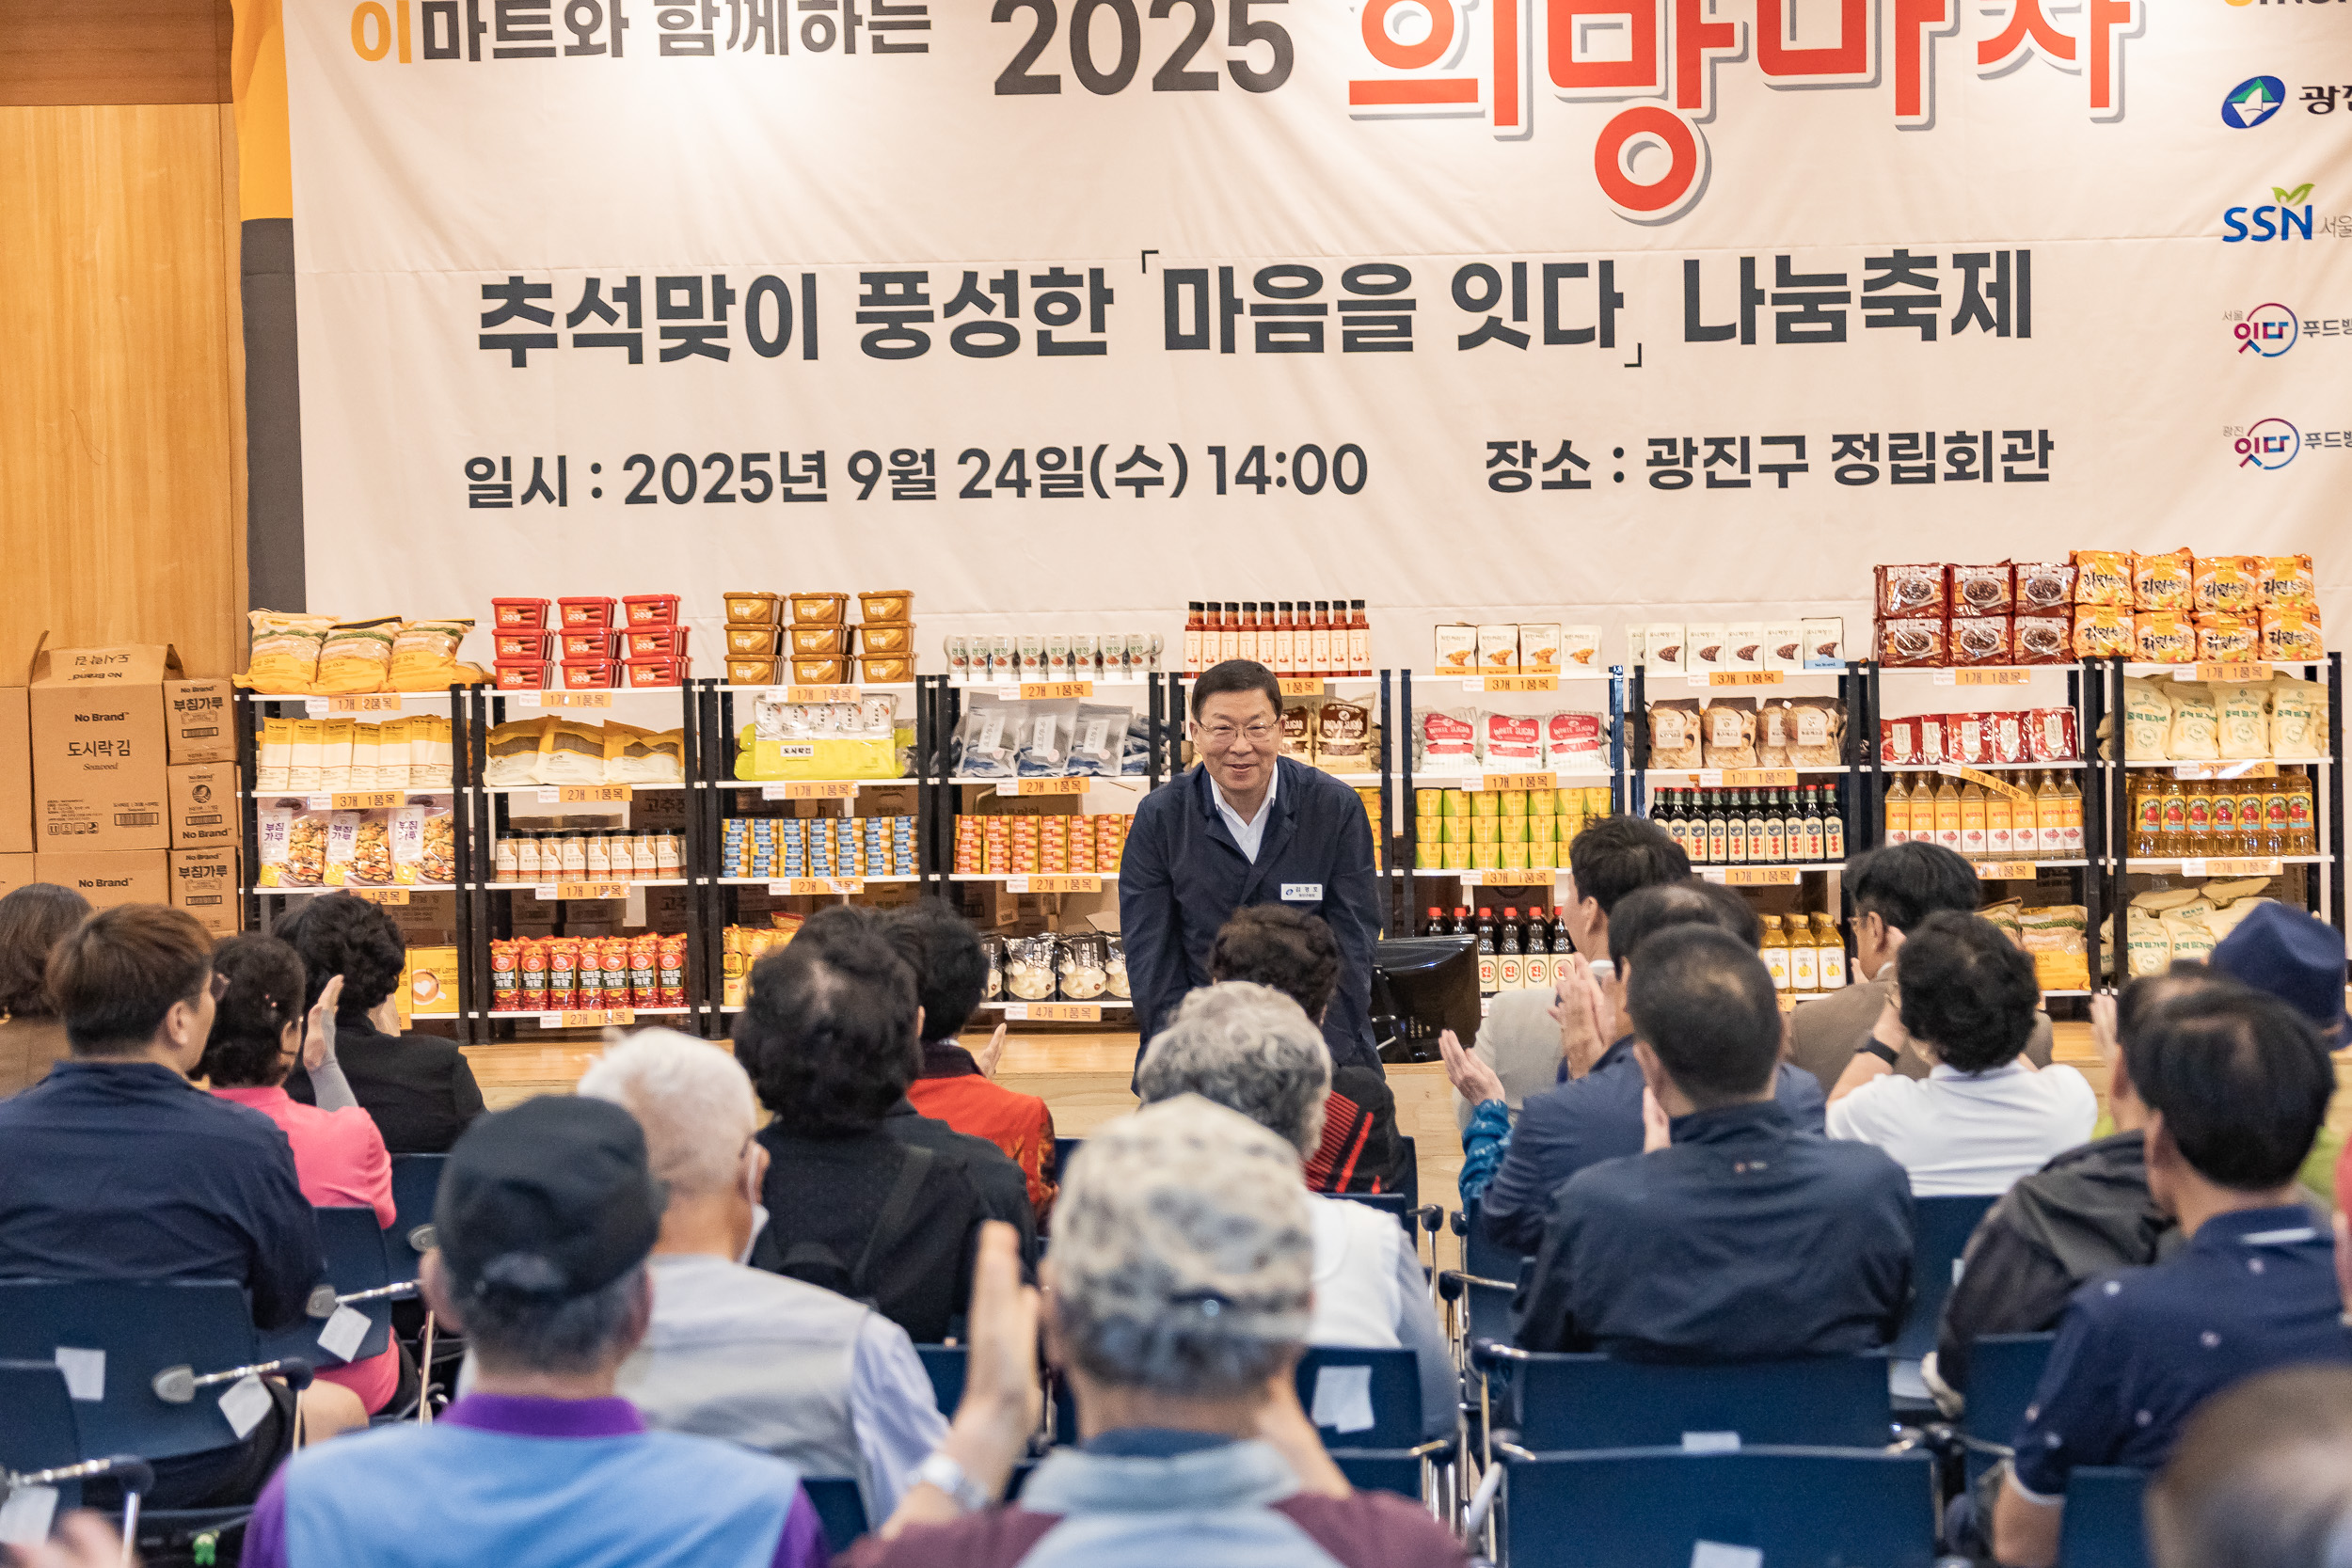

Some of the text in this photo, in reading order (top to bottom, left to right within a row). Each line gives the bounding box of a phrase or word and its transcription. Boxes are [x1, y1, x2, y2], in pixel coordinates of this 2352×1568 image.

[351, 0, 628, 63] 이마트와
[657, 0, 931, 56] 함께하는
[990, 0, 1295, 95] 2025
[2298, 86, 2352, 115] 광
[2222, 205, 2312, 242] SSN
[478, 273, 819, 368] 추석맞이
[854, 267, 1115, 360] 풍성한
[1683, 249, 2032, 345] 나눔축제
[1486, 439, 1592, 493] 장소
[1645, 435, 1809, 490] 광진구
[1830, 430, 2055, 486] 정립회관
[463, 454, 568, 509] 일시
[623, 450, 830, 506] 2025년
[847, 447, 937, 502] 9월
[957, 444, 1188, 499] 24일(수)
[1207, 442, 1369, 496] 14:00
[2206, 666, 2263, 678] 1개 1품목
[1492, 679, 1549, 690] 3개 1품목
[1964, 673, 1982, 684] 1개
[1028, 685, 1084, 697] 2개 1품목
[1286, 681, 1314, 693] 1품목
[577, 694, 604, 706] 1품목
[797, 689, 851, 701] 1개 1품목
[173, 696, 224, 712] 부침가루
[338, 699, 356, 711] 1개
[363, 697, 393, 711] 2품목
[74, 712, 125, 722] No Brand
[1450, 725, 1470, 735] SUGAR
[1516, 727, 1535, 736] SUGAR
[1575, 725, 1596, 734] SUGAR
[67, 739, 131, 758] 도시락 김
[1492, 776, 1548, 788] 1개 1품목
[1731, 772, 1788, 784] 1개 1품목
[794, 785, 849, 797] 1개 1품목
[1026, 780, 1081, 793] 2개 1품목
[567, 788, 623, 800] 2개 1품목
[340, 796, 358, 807] 3개
[368, 794, 395, 806] 1품목
[182, 829, 228, 840] No Brand
[334, 824, 353, 833] 부침
[179, 864, 228, 879] 부침가루
[1490, 872, 1508, 883] 3개
[1735, 870, 1790, 882] 1개 1품목
[78, 878, 129, 888] No Brand
[799, 881, 817, 893] 2개
[1036, 878, 1092, 891] 2개 1품목
[566, 886, 583, 896] 1개
[1036, 1006, 1091, 1019] 4개 1품목
[570, 1014, 588, 1025] 2개
